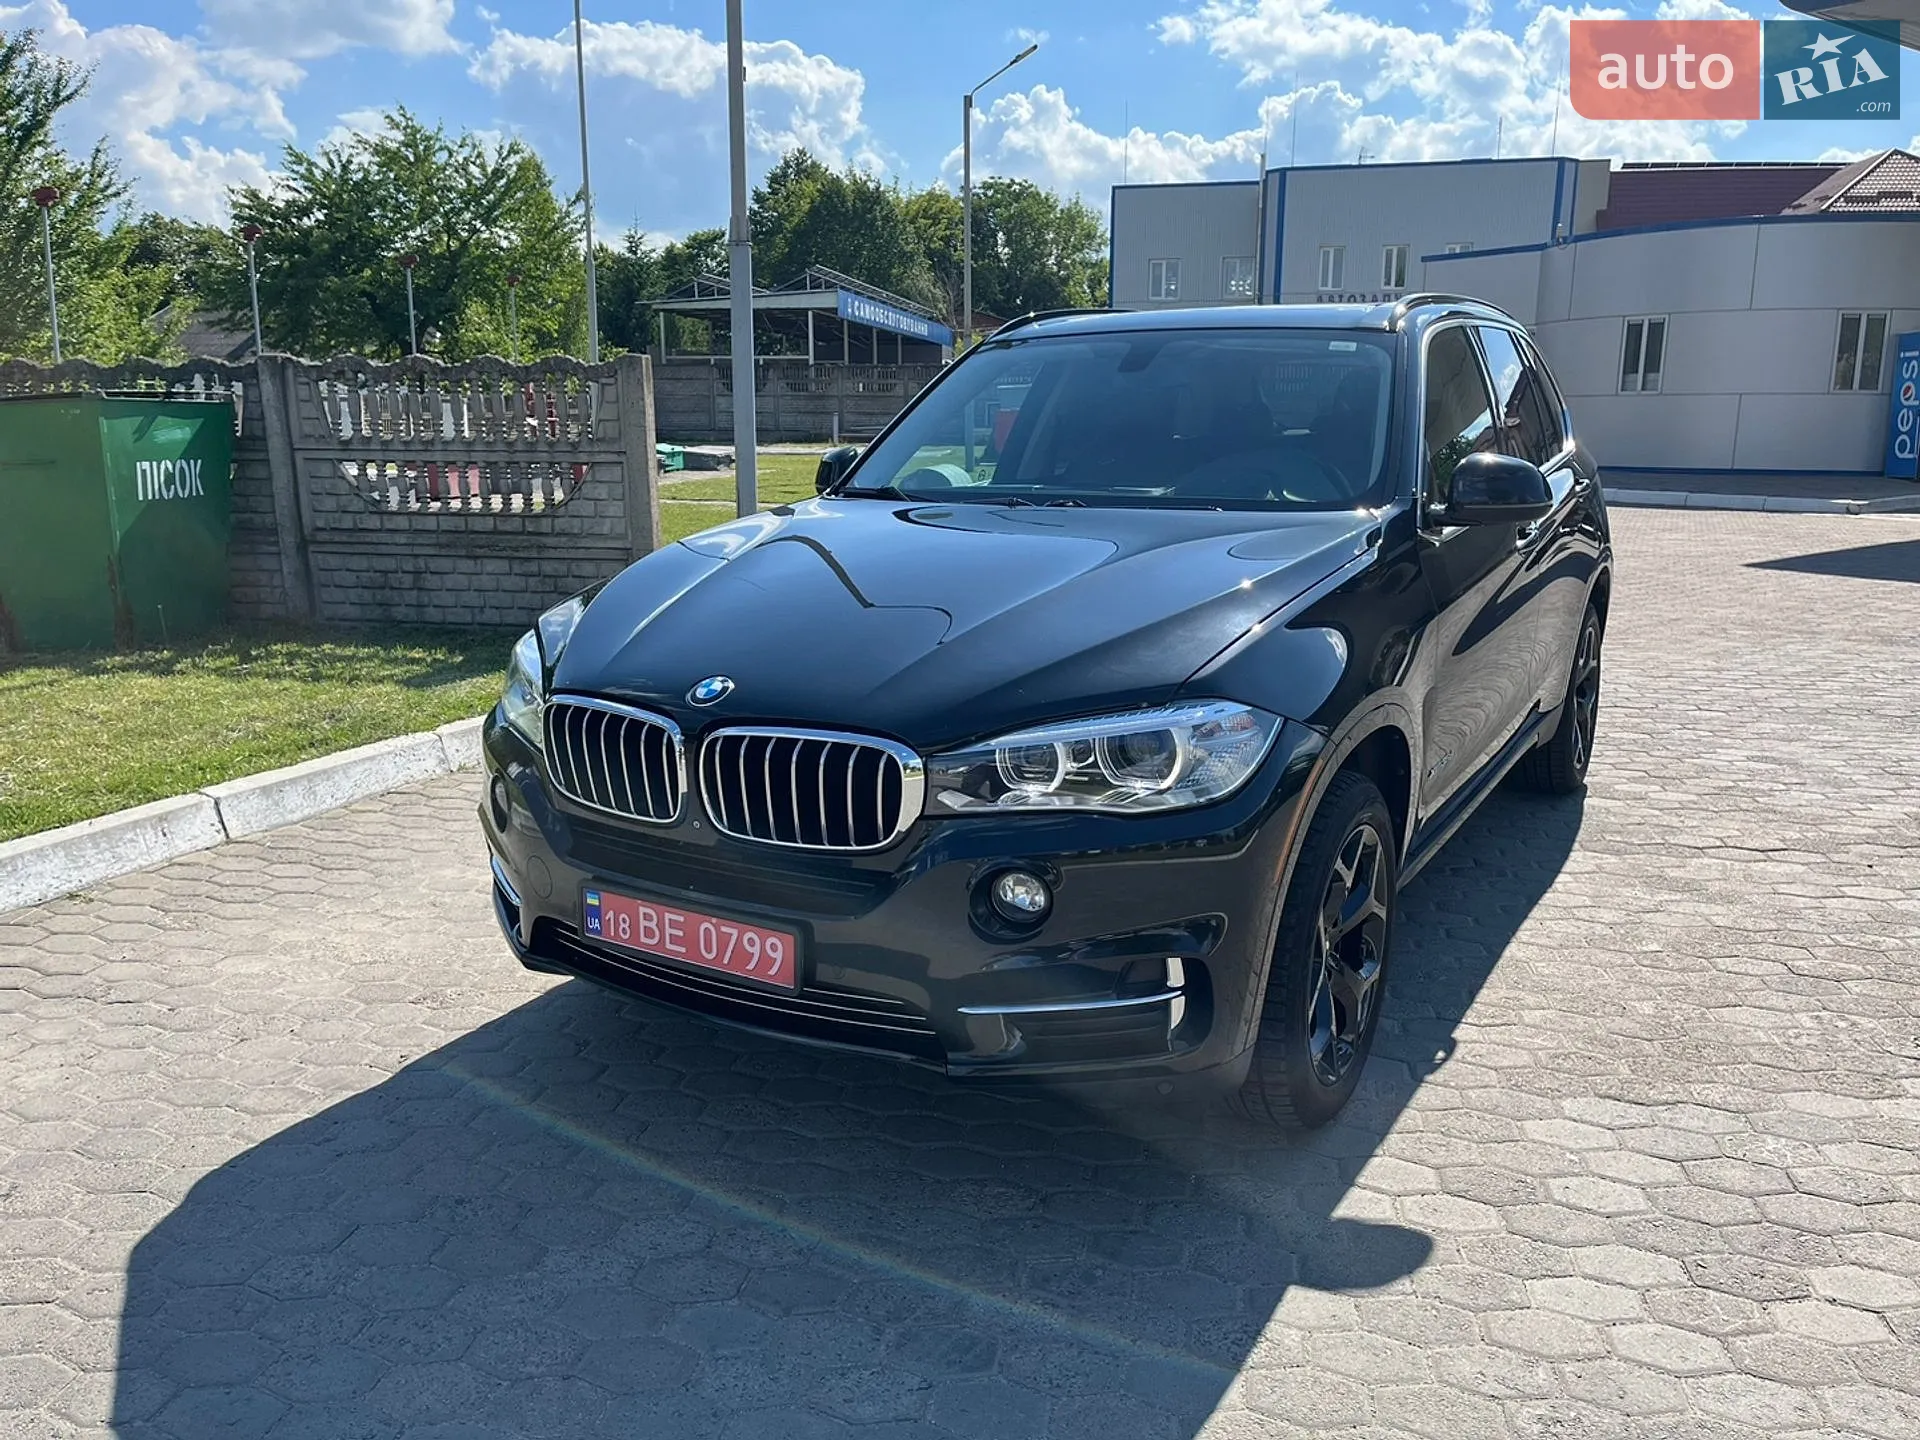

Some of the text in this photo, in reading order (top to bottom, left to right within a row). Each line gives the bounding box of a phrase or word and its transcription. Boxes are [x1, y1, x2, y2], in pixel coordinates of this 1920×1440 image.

[1895, 351, 1919, 459] pepsi
[136, 458, 203, 500] ПІСОК
[587, 916, 601, 929] UA
[605, 906, 784, 976] 18 BE 0799
